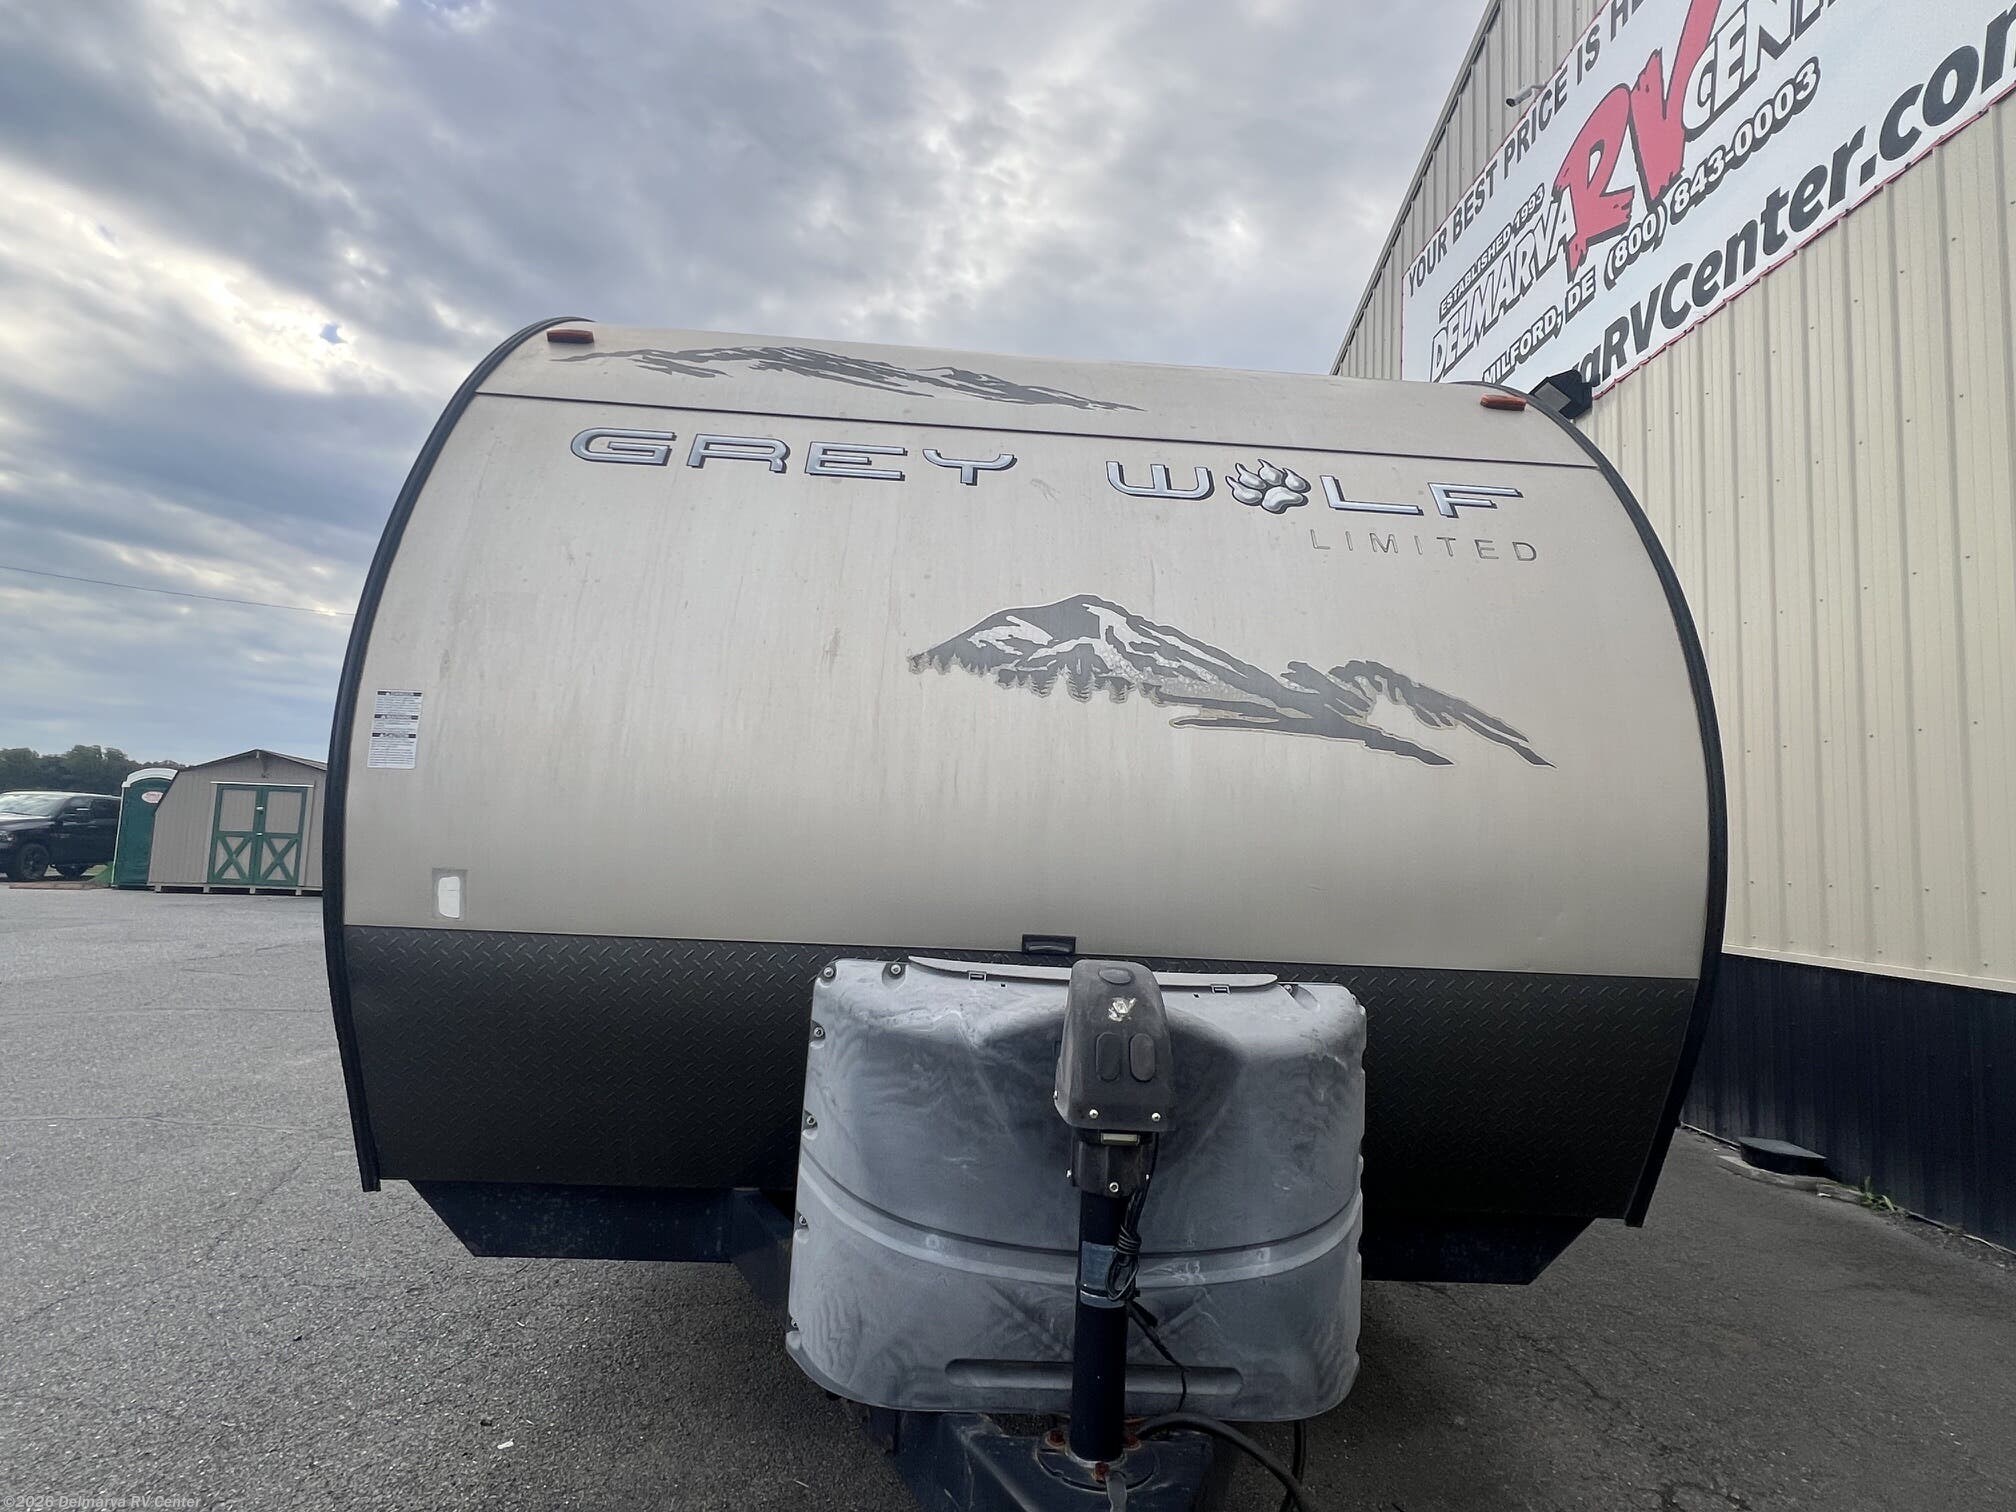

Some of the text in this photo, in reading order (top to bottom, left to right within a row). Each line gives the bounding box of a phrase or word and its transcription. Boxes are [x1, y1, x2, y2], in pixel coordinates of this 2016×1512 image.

[1408, 226, 1448, 298] YOUR
[1453, 160, 1498, 245] BEST
[1504, 65, 1568, 180] PRICE
[1577, 24, 1600, 85] IS
[1430, 0, 1837, 383] DELMARVA RV CEN
[1439, 183, 1545, 324] ESTABLISHED 1993
[1482, 56, 1821, 386] MILFORD, DE (800) 843-0003
[1572, 2, 2016, 388] aRVCenter.co
[570, 427, 1018, 486] GREY
[1310, 529, 1538, 562] LIMITED
